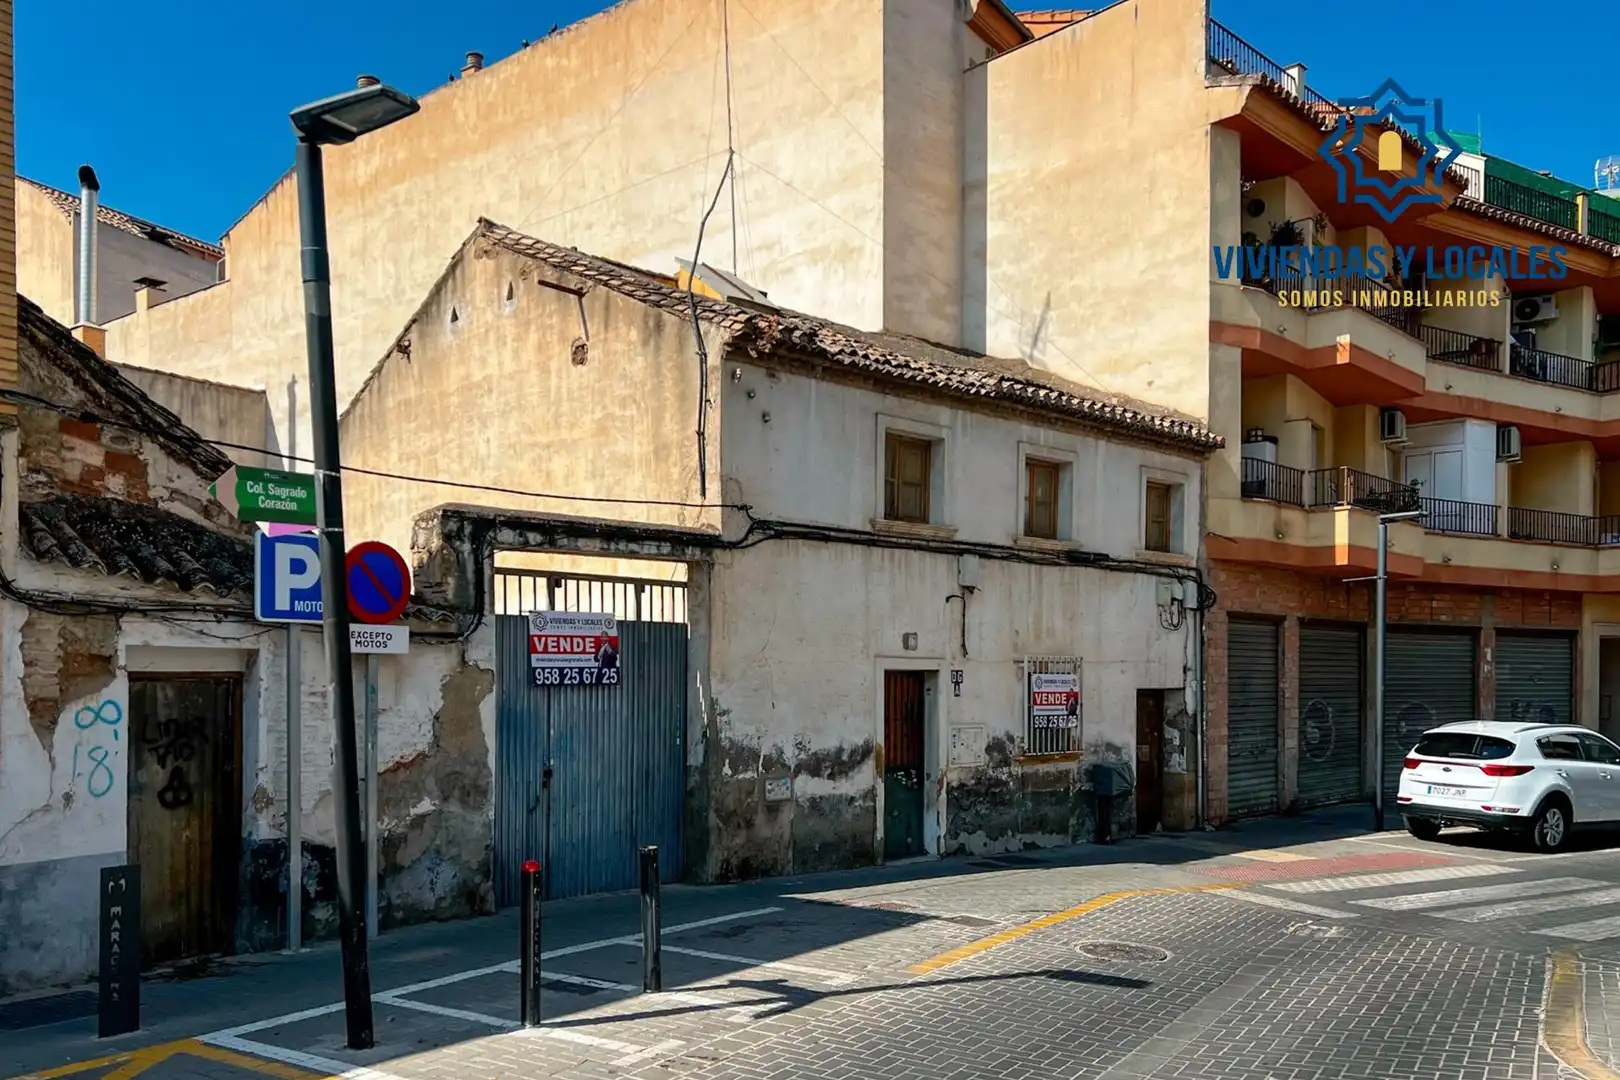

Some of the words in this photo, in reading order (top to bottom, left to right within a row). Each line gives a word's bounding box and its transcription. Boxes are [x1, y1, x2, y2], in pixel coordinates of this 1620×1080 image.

[246, 480, 266, 494] Col.
[267, 482, 307, 499] Sagrado
[258, 495, 298, 511] Corazón
[275, 542, 321, 611] P
[294, 600, 323, 612] MOTO
[350, 631, 393, 641] EXCEPTO
[355, 639, 388, 649] MOTOS
[533, 636, 596, 653] VENDE
[535, 668, 560, 685] 958
[563, 668, 580, 684] 25
[583, 668, 598, 684] 67
[602, 668, 618, 684] 25
[1034, 693, 1067, 705] VENDE
[1034, 715, 1048, 728] 958
[1048, 715, 1058, 728] 25
[1058, 715, 1067, 727] 67
[1067, 715, 1077, 727] 25
[1432, 787, 1451, 796] 7027
